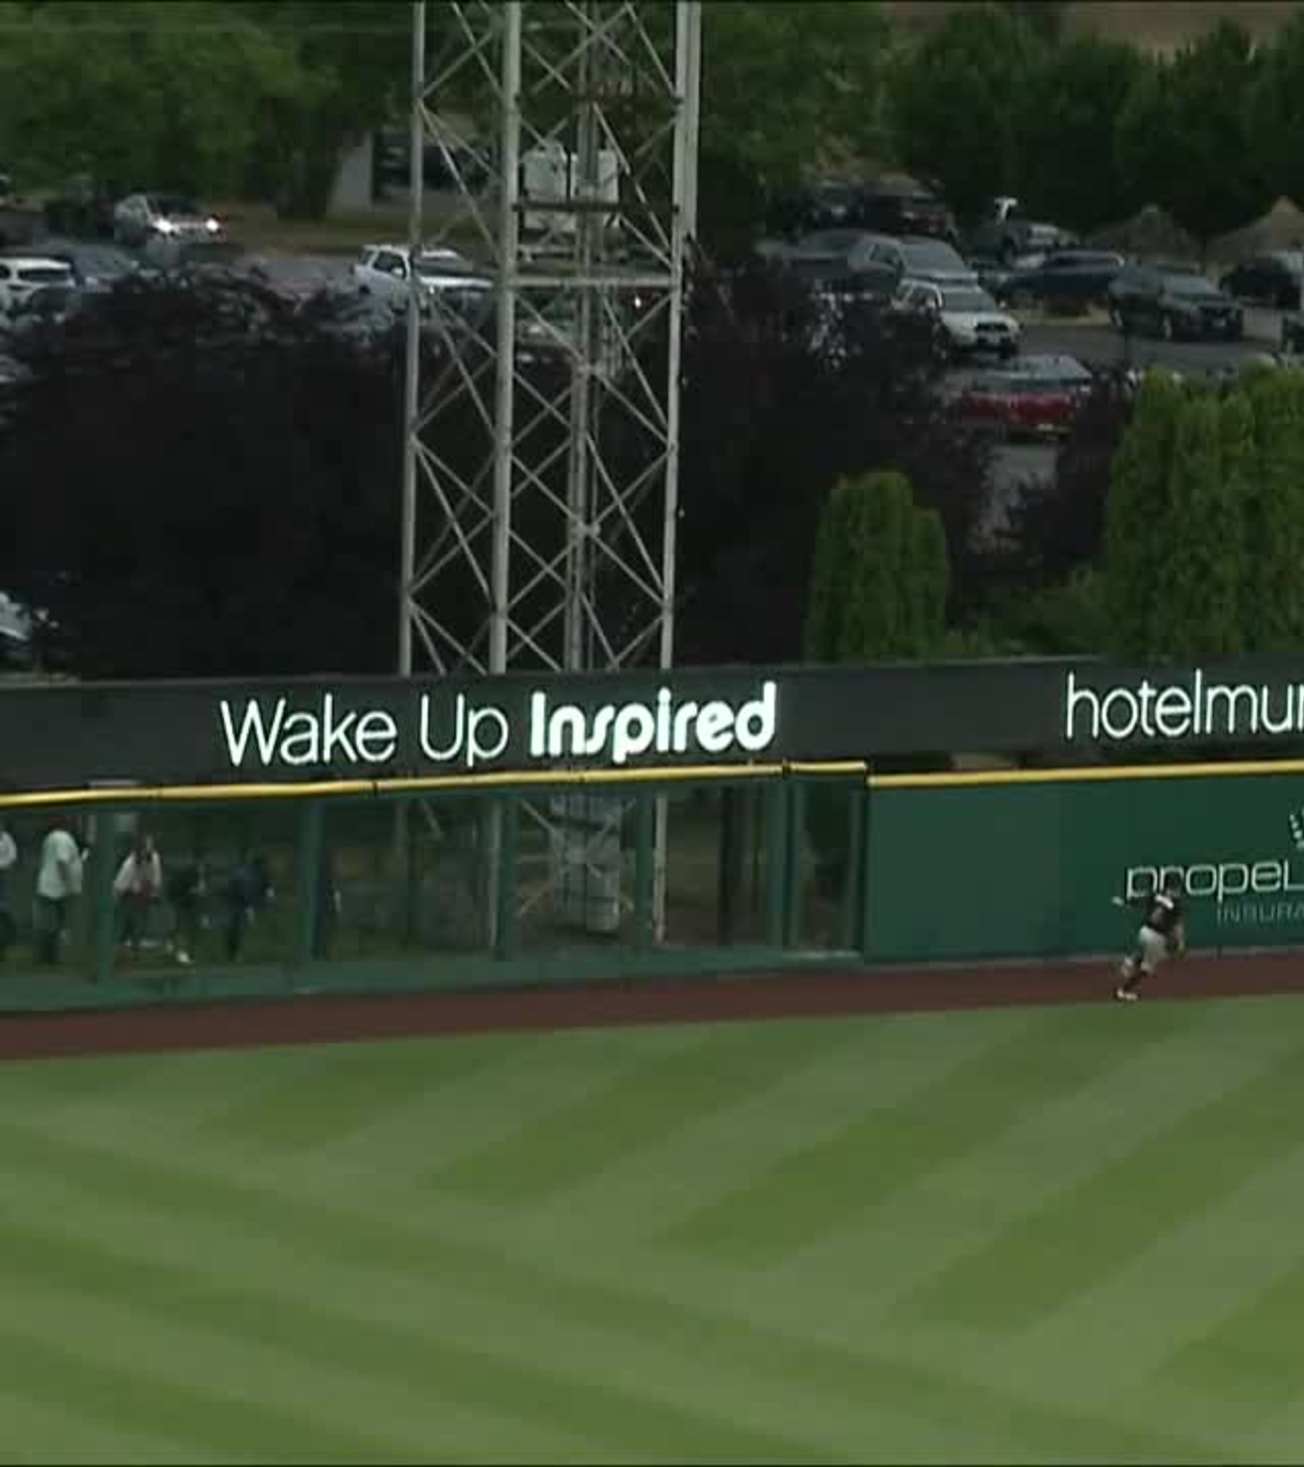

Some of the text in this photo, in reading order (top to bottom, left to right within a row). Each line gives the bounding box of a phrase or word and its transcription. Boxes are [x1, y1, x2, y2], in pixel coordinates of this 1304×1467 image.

[220, 681, 777, 767] Wake Up Inspired
